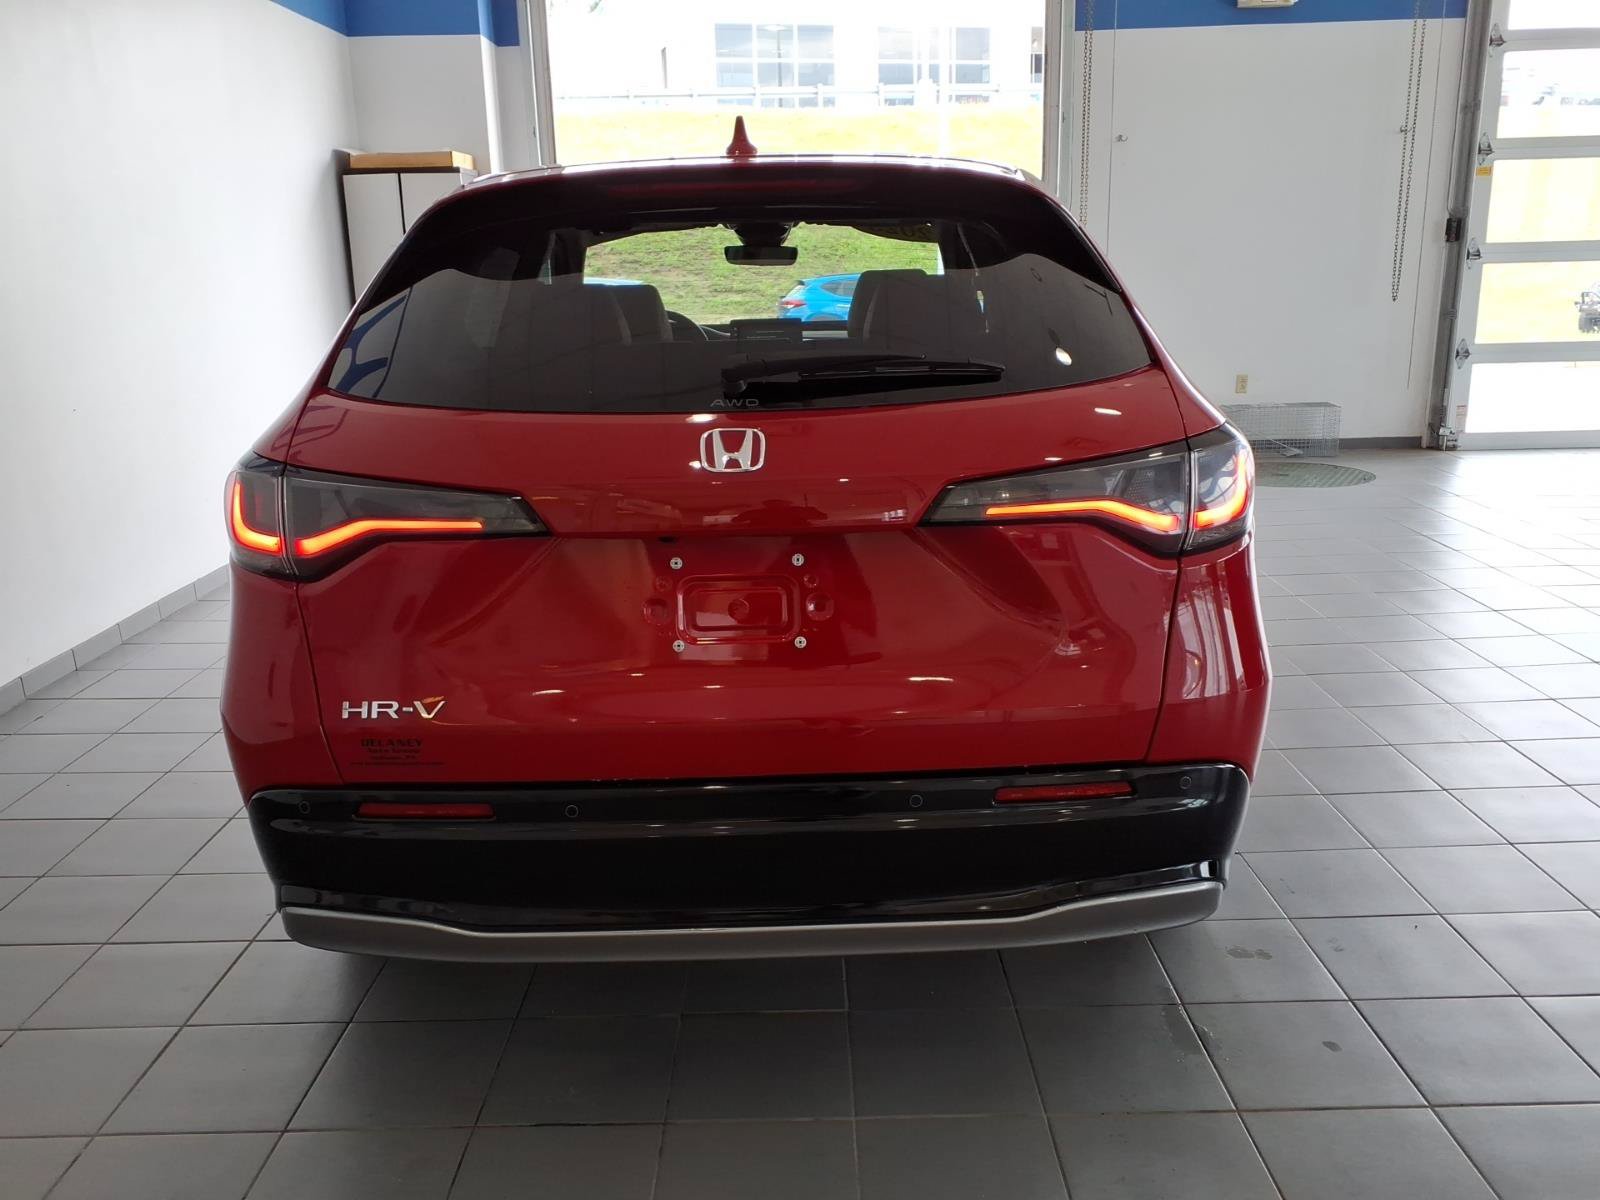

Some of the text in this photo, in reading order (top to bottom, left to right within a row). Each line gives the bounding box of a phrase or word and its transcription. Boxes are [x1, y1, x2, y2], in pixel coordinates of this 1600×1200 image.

[710, 398, 760, 408] AWD
[341, 700, 446, 720] HR-V
[360, 738, 423, 748] DELANEY
